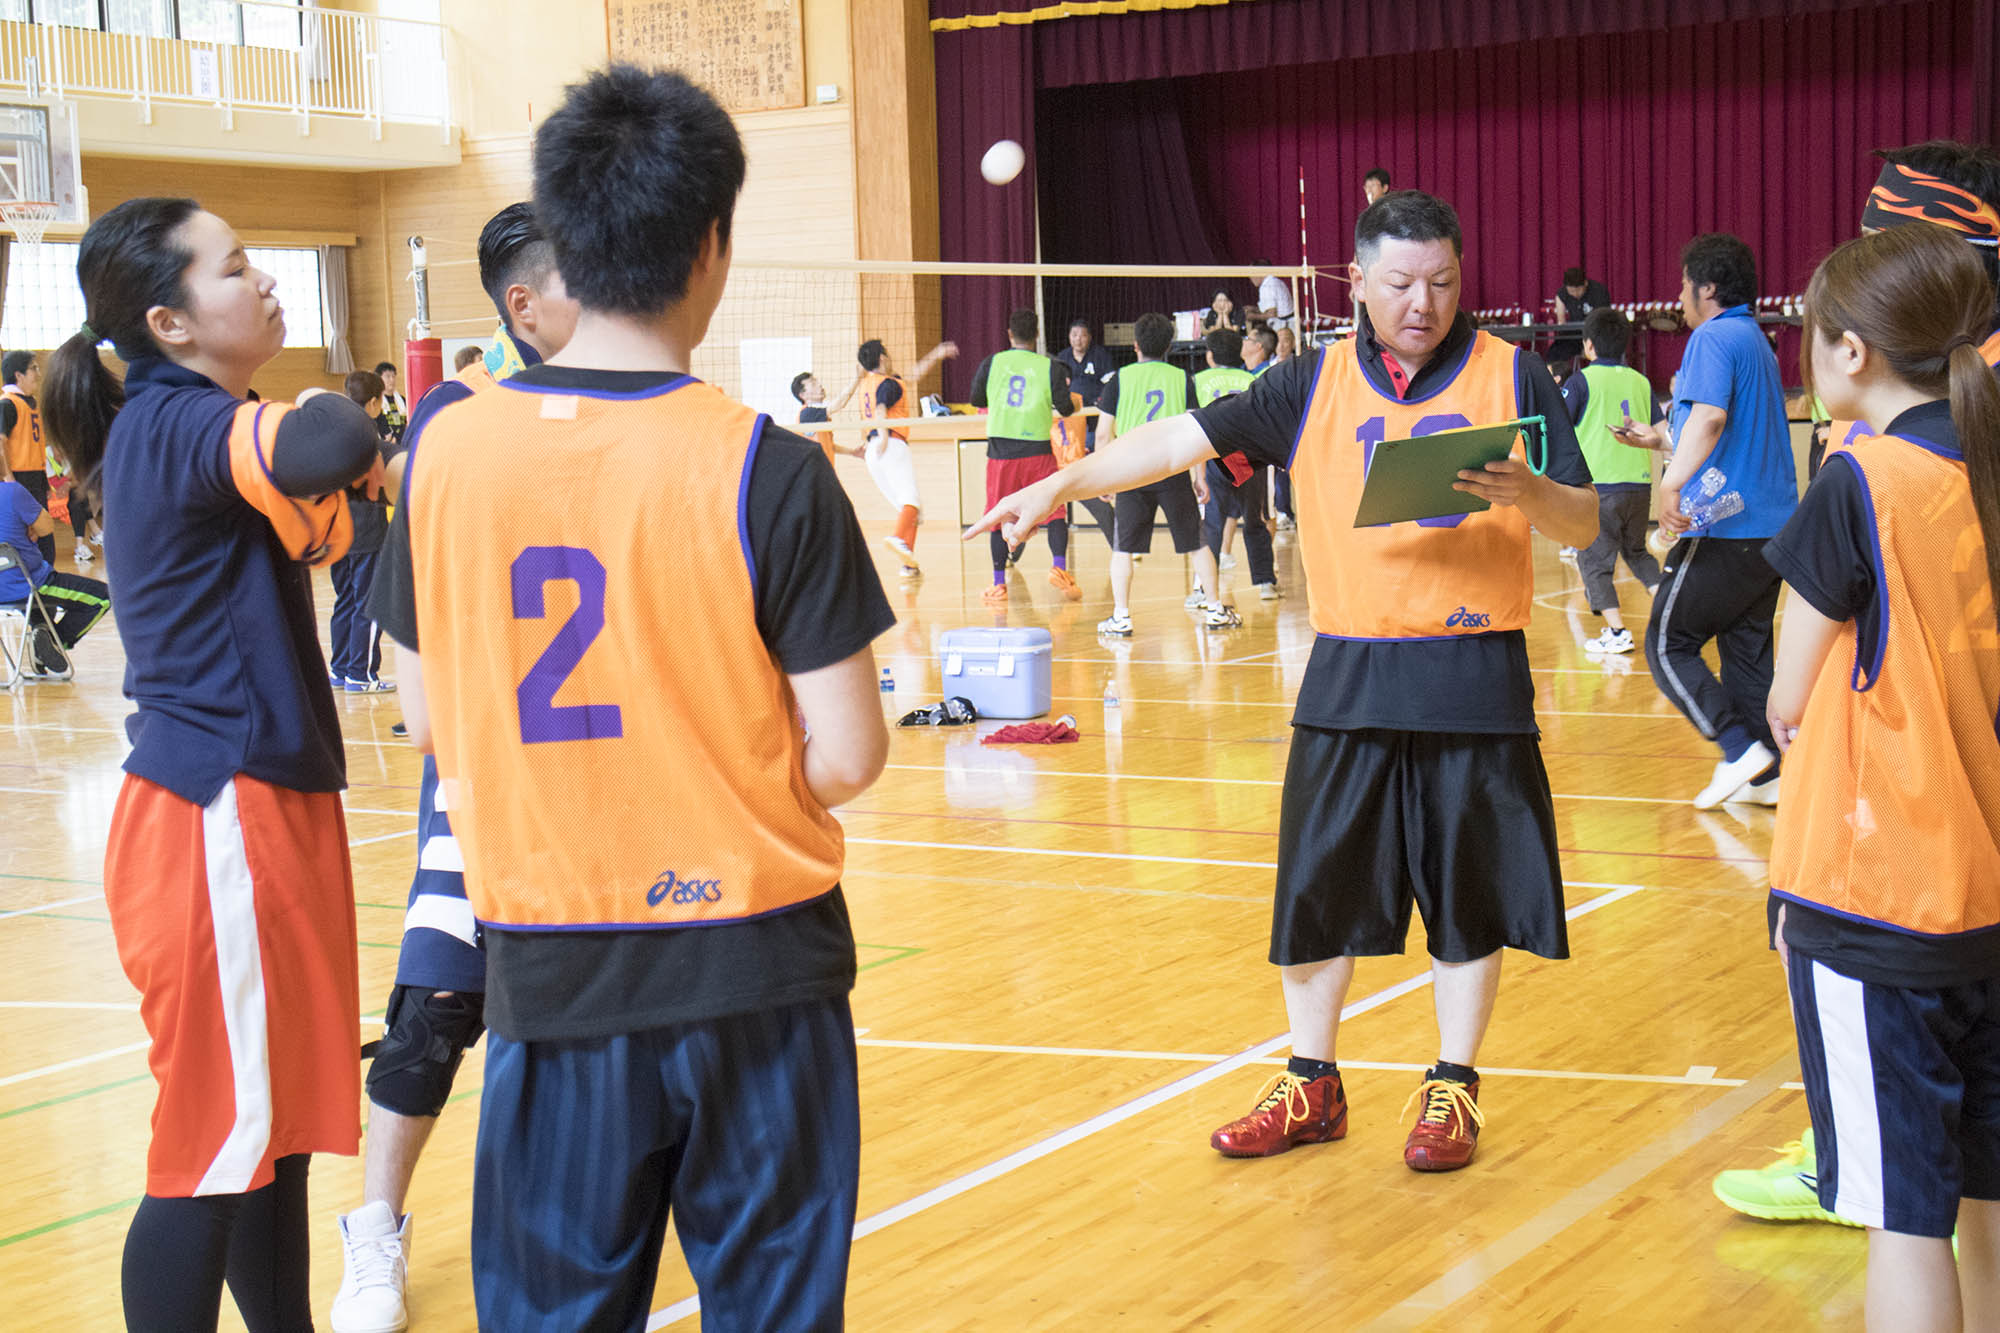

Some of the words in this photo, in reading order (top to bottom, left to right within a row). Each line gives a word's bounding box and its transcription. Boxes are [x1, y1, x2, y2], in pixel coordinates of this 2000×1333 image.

[1008, 375, 1026, 407] 8
[1146, 389, 1164, 422] 2
[31, 413, 40, 442] 5
[510, 545, 623, 744] 2
